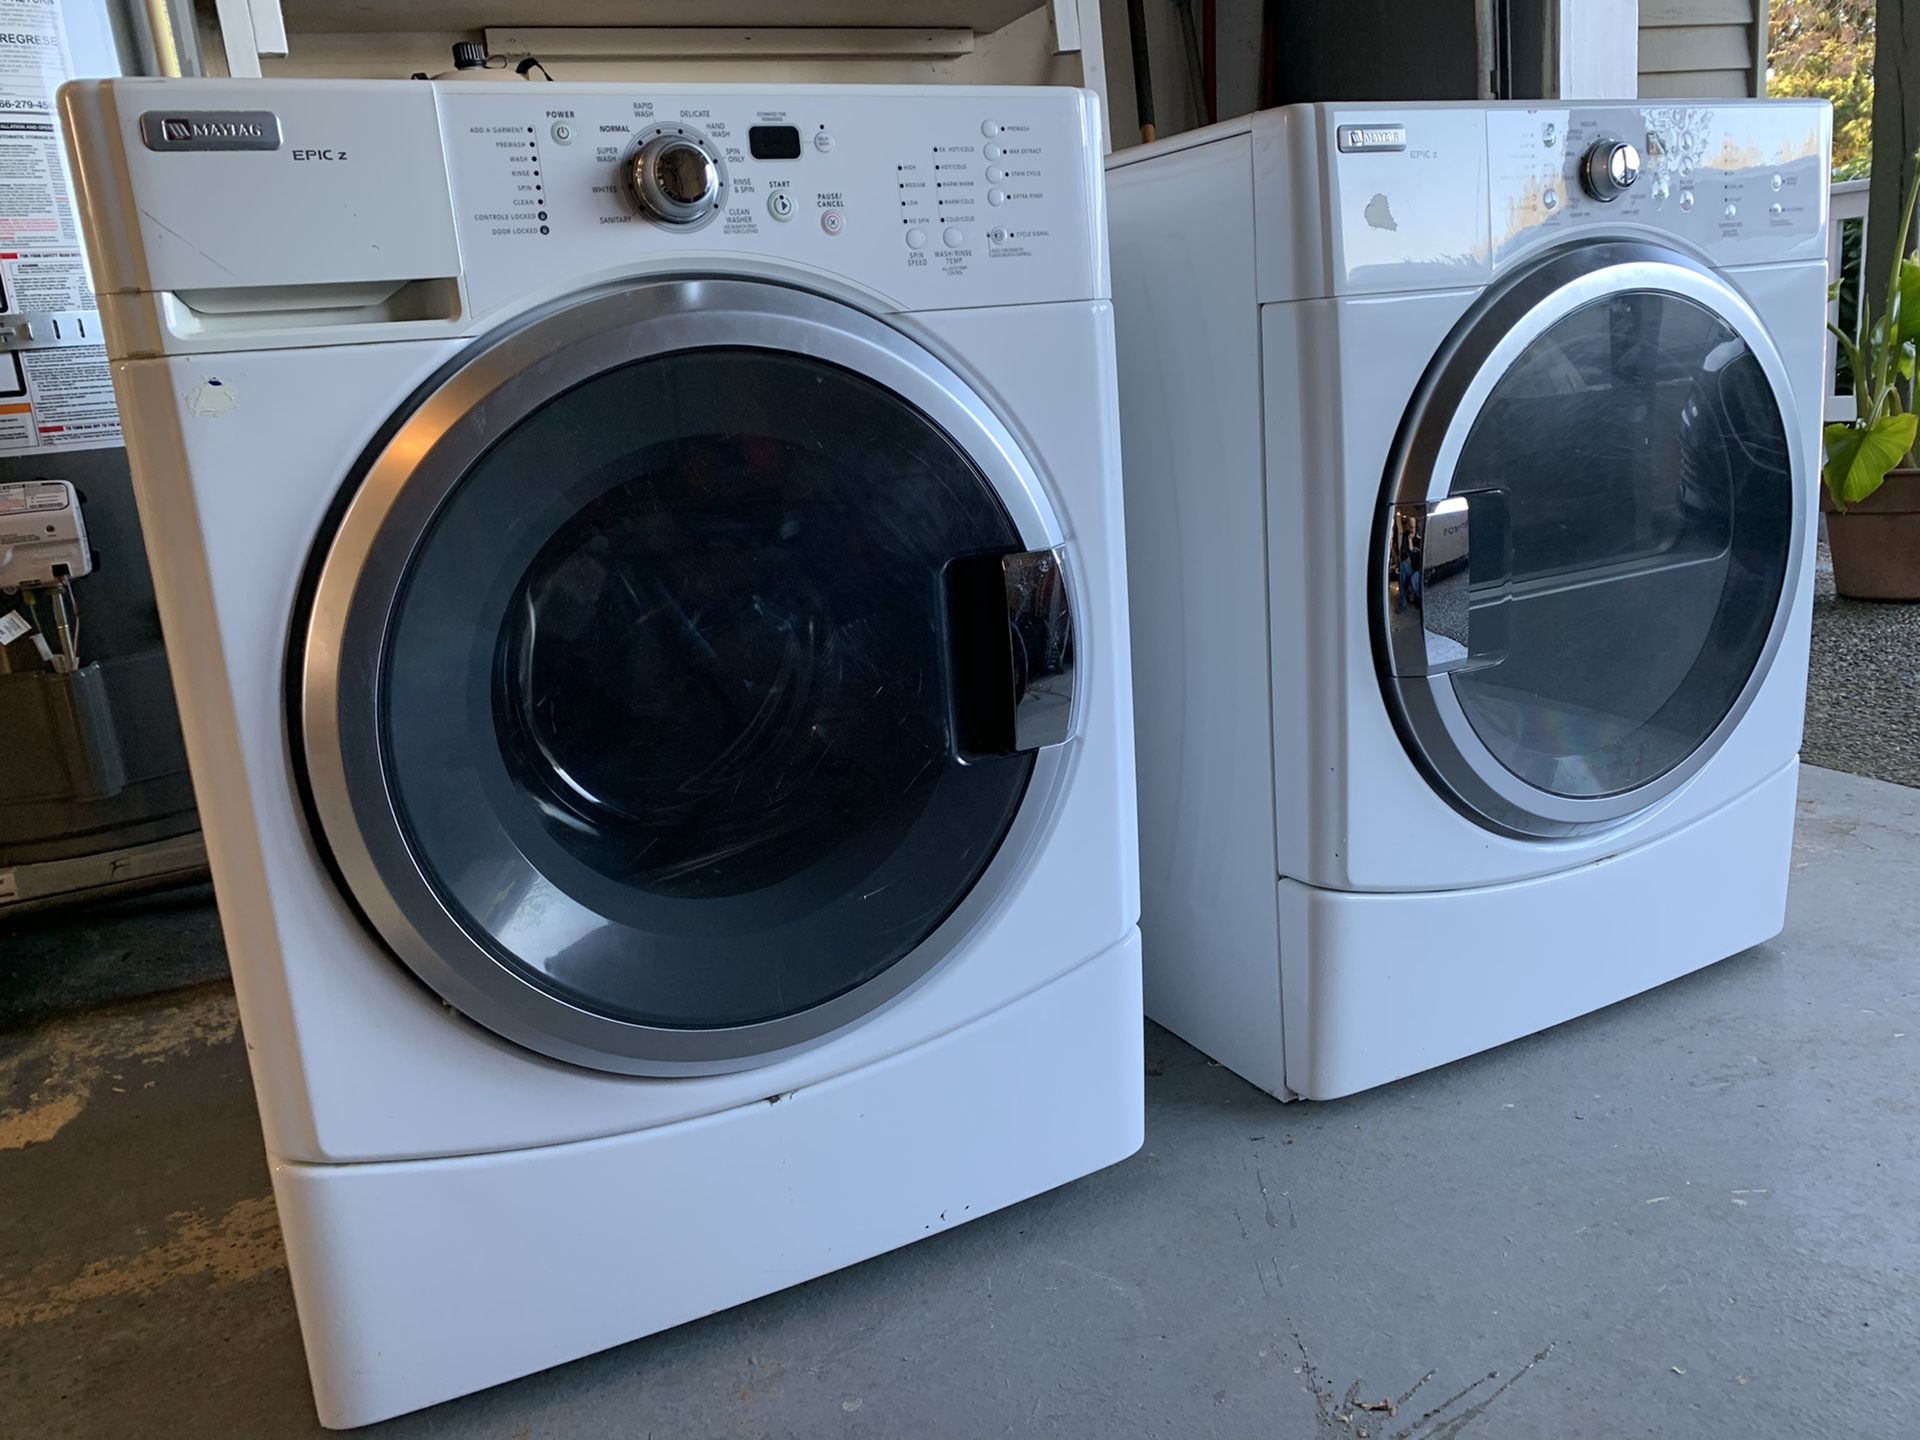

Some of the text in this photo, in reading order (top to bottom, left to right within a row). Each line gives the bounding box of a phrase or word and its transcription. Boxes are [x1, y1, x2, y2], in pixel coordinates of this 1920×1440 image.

[633, 102, 654, 110] RAPID
[546, 110, 575, 119] POWER
[634, 110, 654, 118] WASH
[680, 110, 710, 118] DELICATE
[192, 123, 263, 137] MAYTAG
[599, 125, 630, 133] NORMAL
[496, 141, 526, 149] PREWASH
[597, 147, 618, 155] SUPER
[1410, 150, 1431, 159] EPIC
[292, 150, 333, 161] EPIC
[596, 155, 617, 163] WASH
[728, 155, 745, 163] ONLY
[517, 184, 532, 192] SPIN
[768, 181, 790, 189] START
[740, 186, 755, 194] SPIN
[817, 193, 843, 201] PAUSE/
[817, 200, 845, 208] CANCEL
[729, 208, 750, 216] CLEAN
[474, 213, 536, 221] CONTROLS LOCKED
[600, 216, 632, 224] SANITARY
[725, 216, 752, 224] WASHER
[492, 227, 538, 236] DOOR LOCKED
[934, 249, 972, 258] WASH/RINSE
[907, 258, 928, 267] SPEED
[946, 257, 962, 265] TEMP
